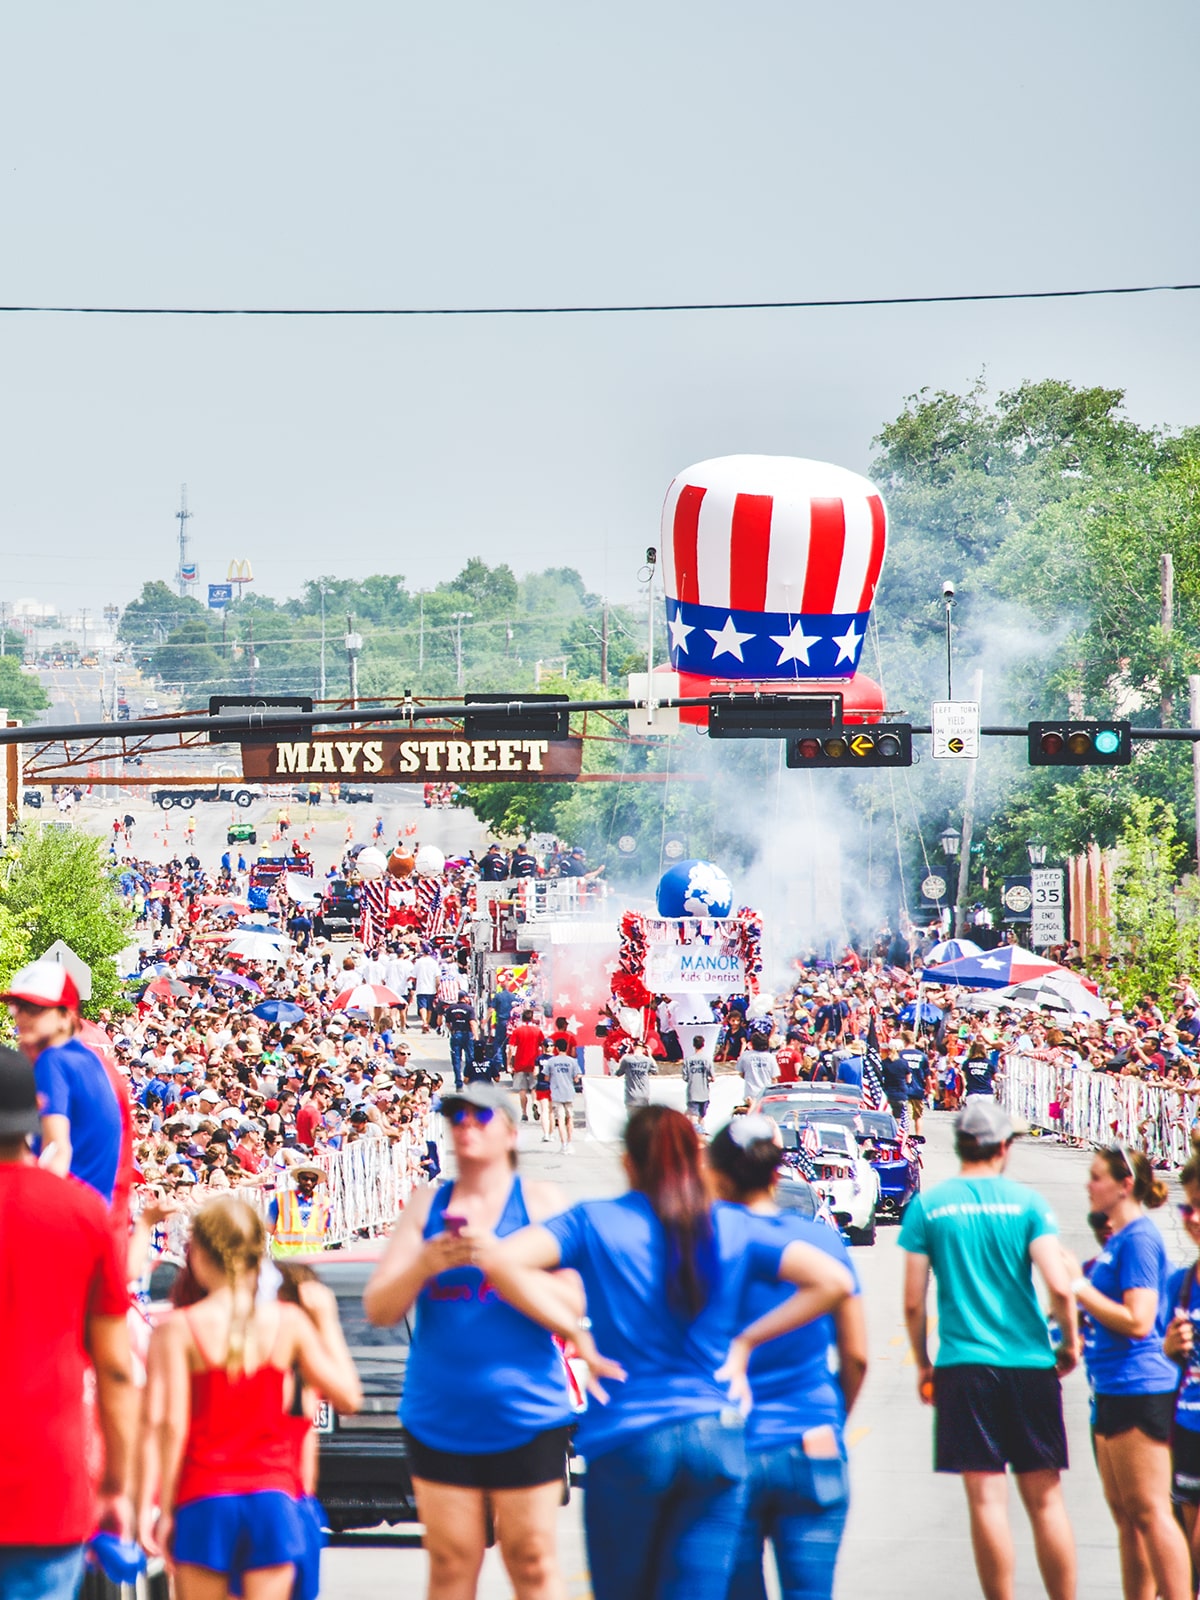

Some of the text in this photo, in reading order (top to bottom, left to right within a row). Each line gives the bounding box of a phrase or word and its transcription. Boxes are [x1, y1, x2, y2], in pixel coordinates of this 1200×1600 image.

[947, 716, 966, 725] YIELD
[275, 740, 548, 773] MAYS STREET
[1036, 889, 1060, 903] 35
[1041, 912, 1056, 920] END
[1034, 923, 1061, 931] SCHOOL
[1041, 934, 1057, 942] ZONE
[680, 955, 739, 971] MANOR
[681, 972, 740, 982] Kids Dentist
